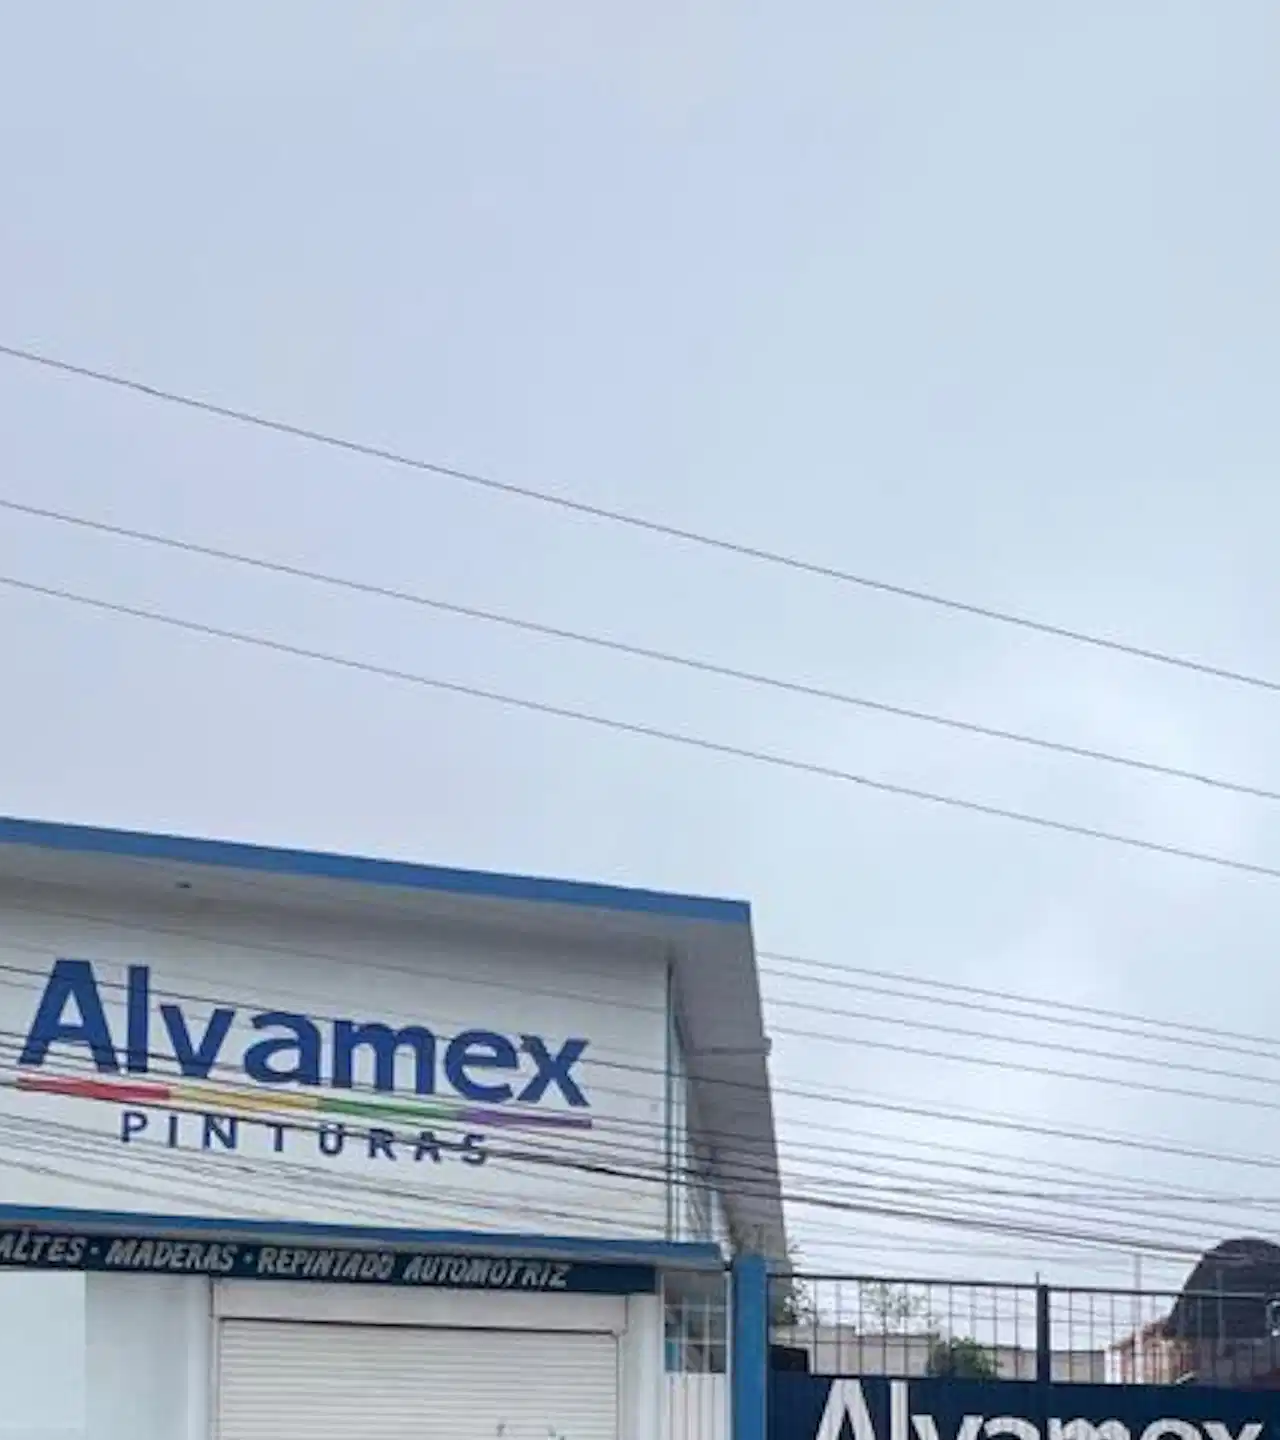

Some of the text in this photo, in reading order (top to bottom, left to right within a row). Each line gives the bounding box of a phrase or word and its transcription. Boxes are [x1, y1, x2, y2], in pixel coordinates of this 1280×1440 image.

[18, 960, 592, 1108] Alvamex
[121, 1112, 489, 1166] PINTURAS
[105, 1239, 238, 1272] MADERAS
[258, 1247, 394, 1280] REPINTADO
[403, 1255, 571, 1288] AUTOMOTRIZ
